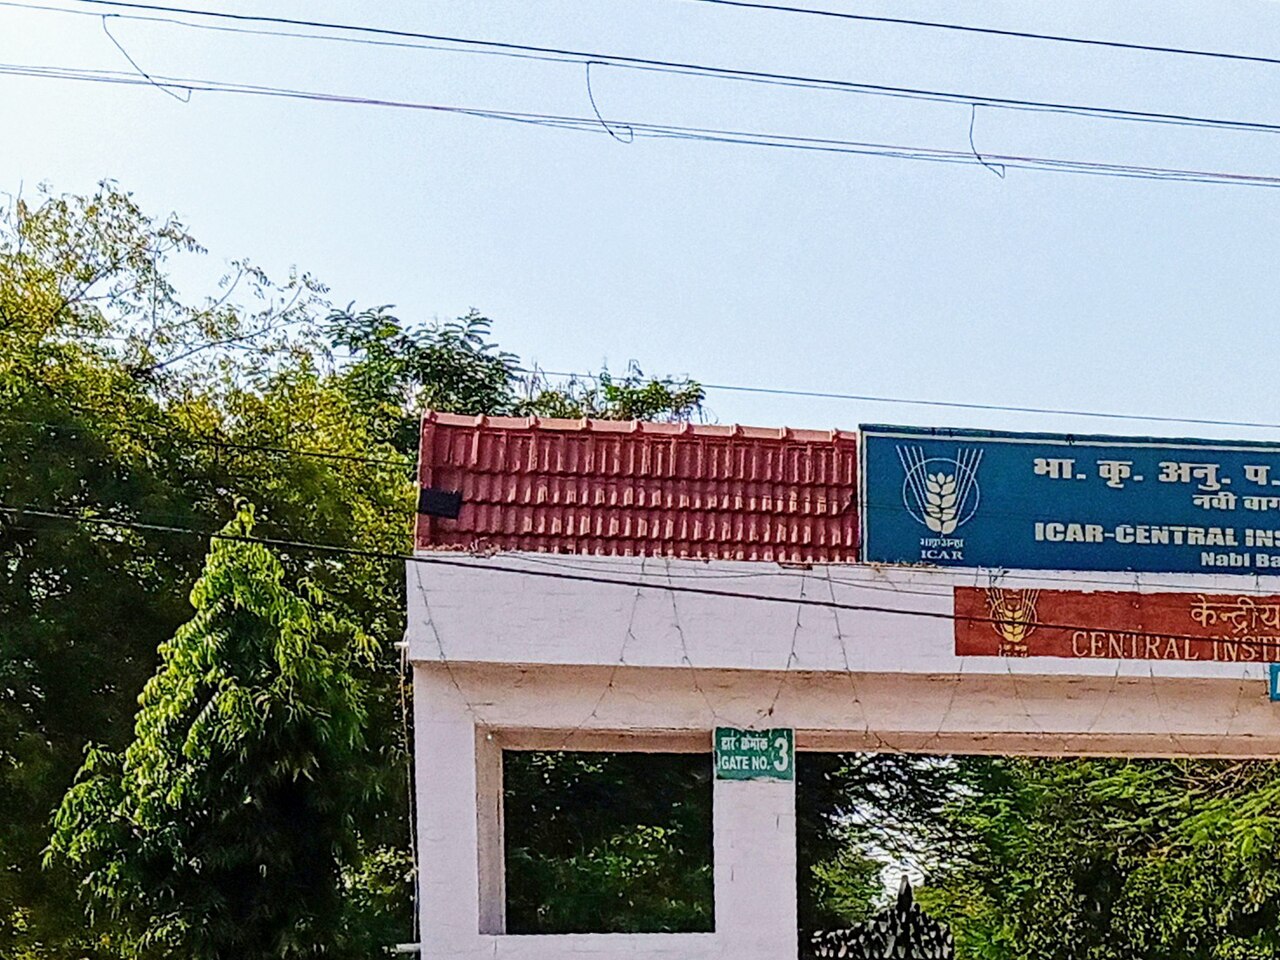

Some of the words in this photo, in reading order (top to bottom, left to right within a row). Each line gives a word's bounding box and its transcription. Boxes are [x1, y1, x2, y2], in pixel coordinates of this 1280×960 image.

[1033, 458, 1086, 480] भा.
[1158, 461, 1231, 491] अनु.
[1244, 465, 1280, 486] प.
[1034, 522, 1239, 547] ICAR-CENTRAL
[921, 549, 964, 560] ICAR
[1190, 594, 1280, 634] केन्द्रीय
[1072, 630, 1199, 660] CENTRAL
[721, 756, 749, 770] GATE
[752, 756, 770, 770] NO.
[773, 737, 789, 772] 3
